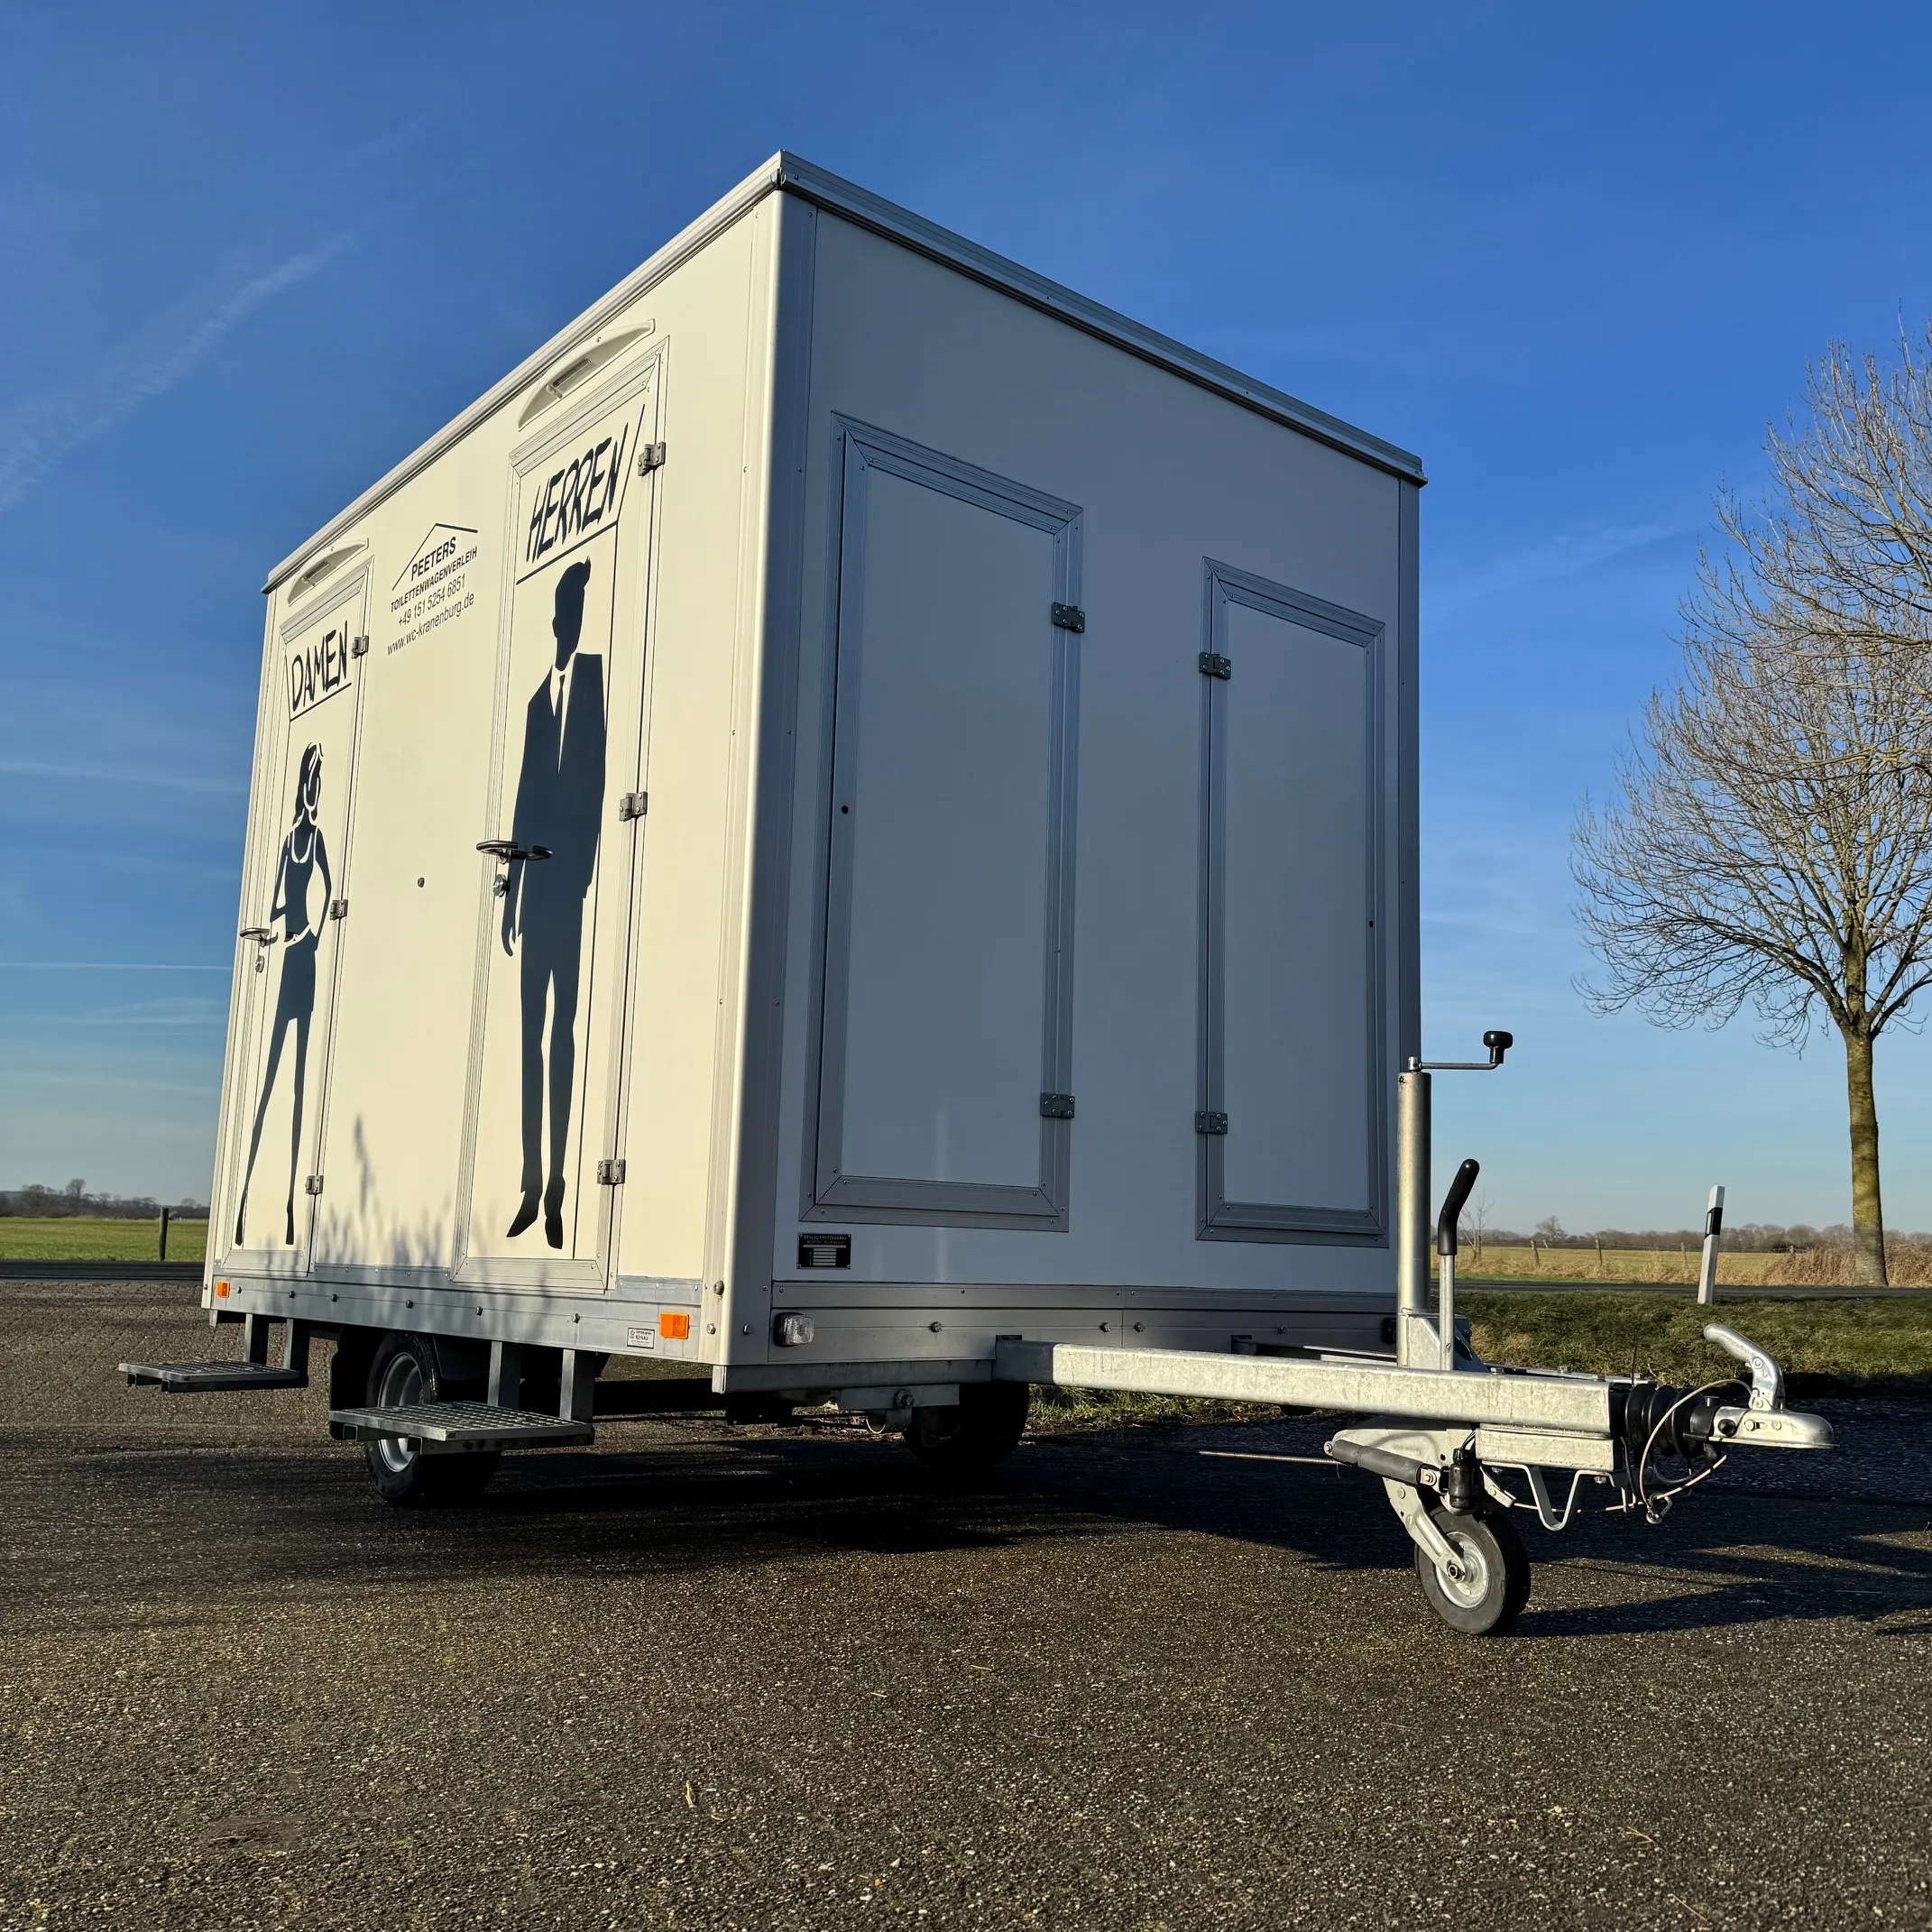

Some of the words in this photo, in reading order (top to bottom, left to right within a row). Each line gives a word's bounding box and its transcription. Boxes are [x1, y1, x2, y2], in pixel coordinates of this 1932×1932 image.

[526, 422, 629, 564] HERREN
[391, 546, 478, 612] TOILETTENWAGENVERLEIH
[410, 536, 456, 582] PEETERS
[387, 592, 474, 656] www.wc-kranenburg.de
[399, 608, 412, 626] +49
[413, 599, 426, 619] 151
[427, 586, 446, 611] 5254
[446, 573, 465, 598] 6851
[291, 620, 348, 713] DAMEN
